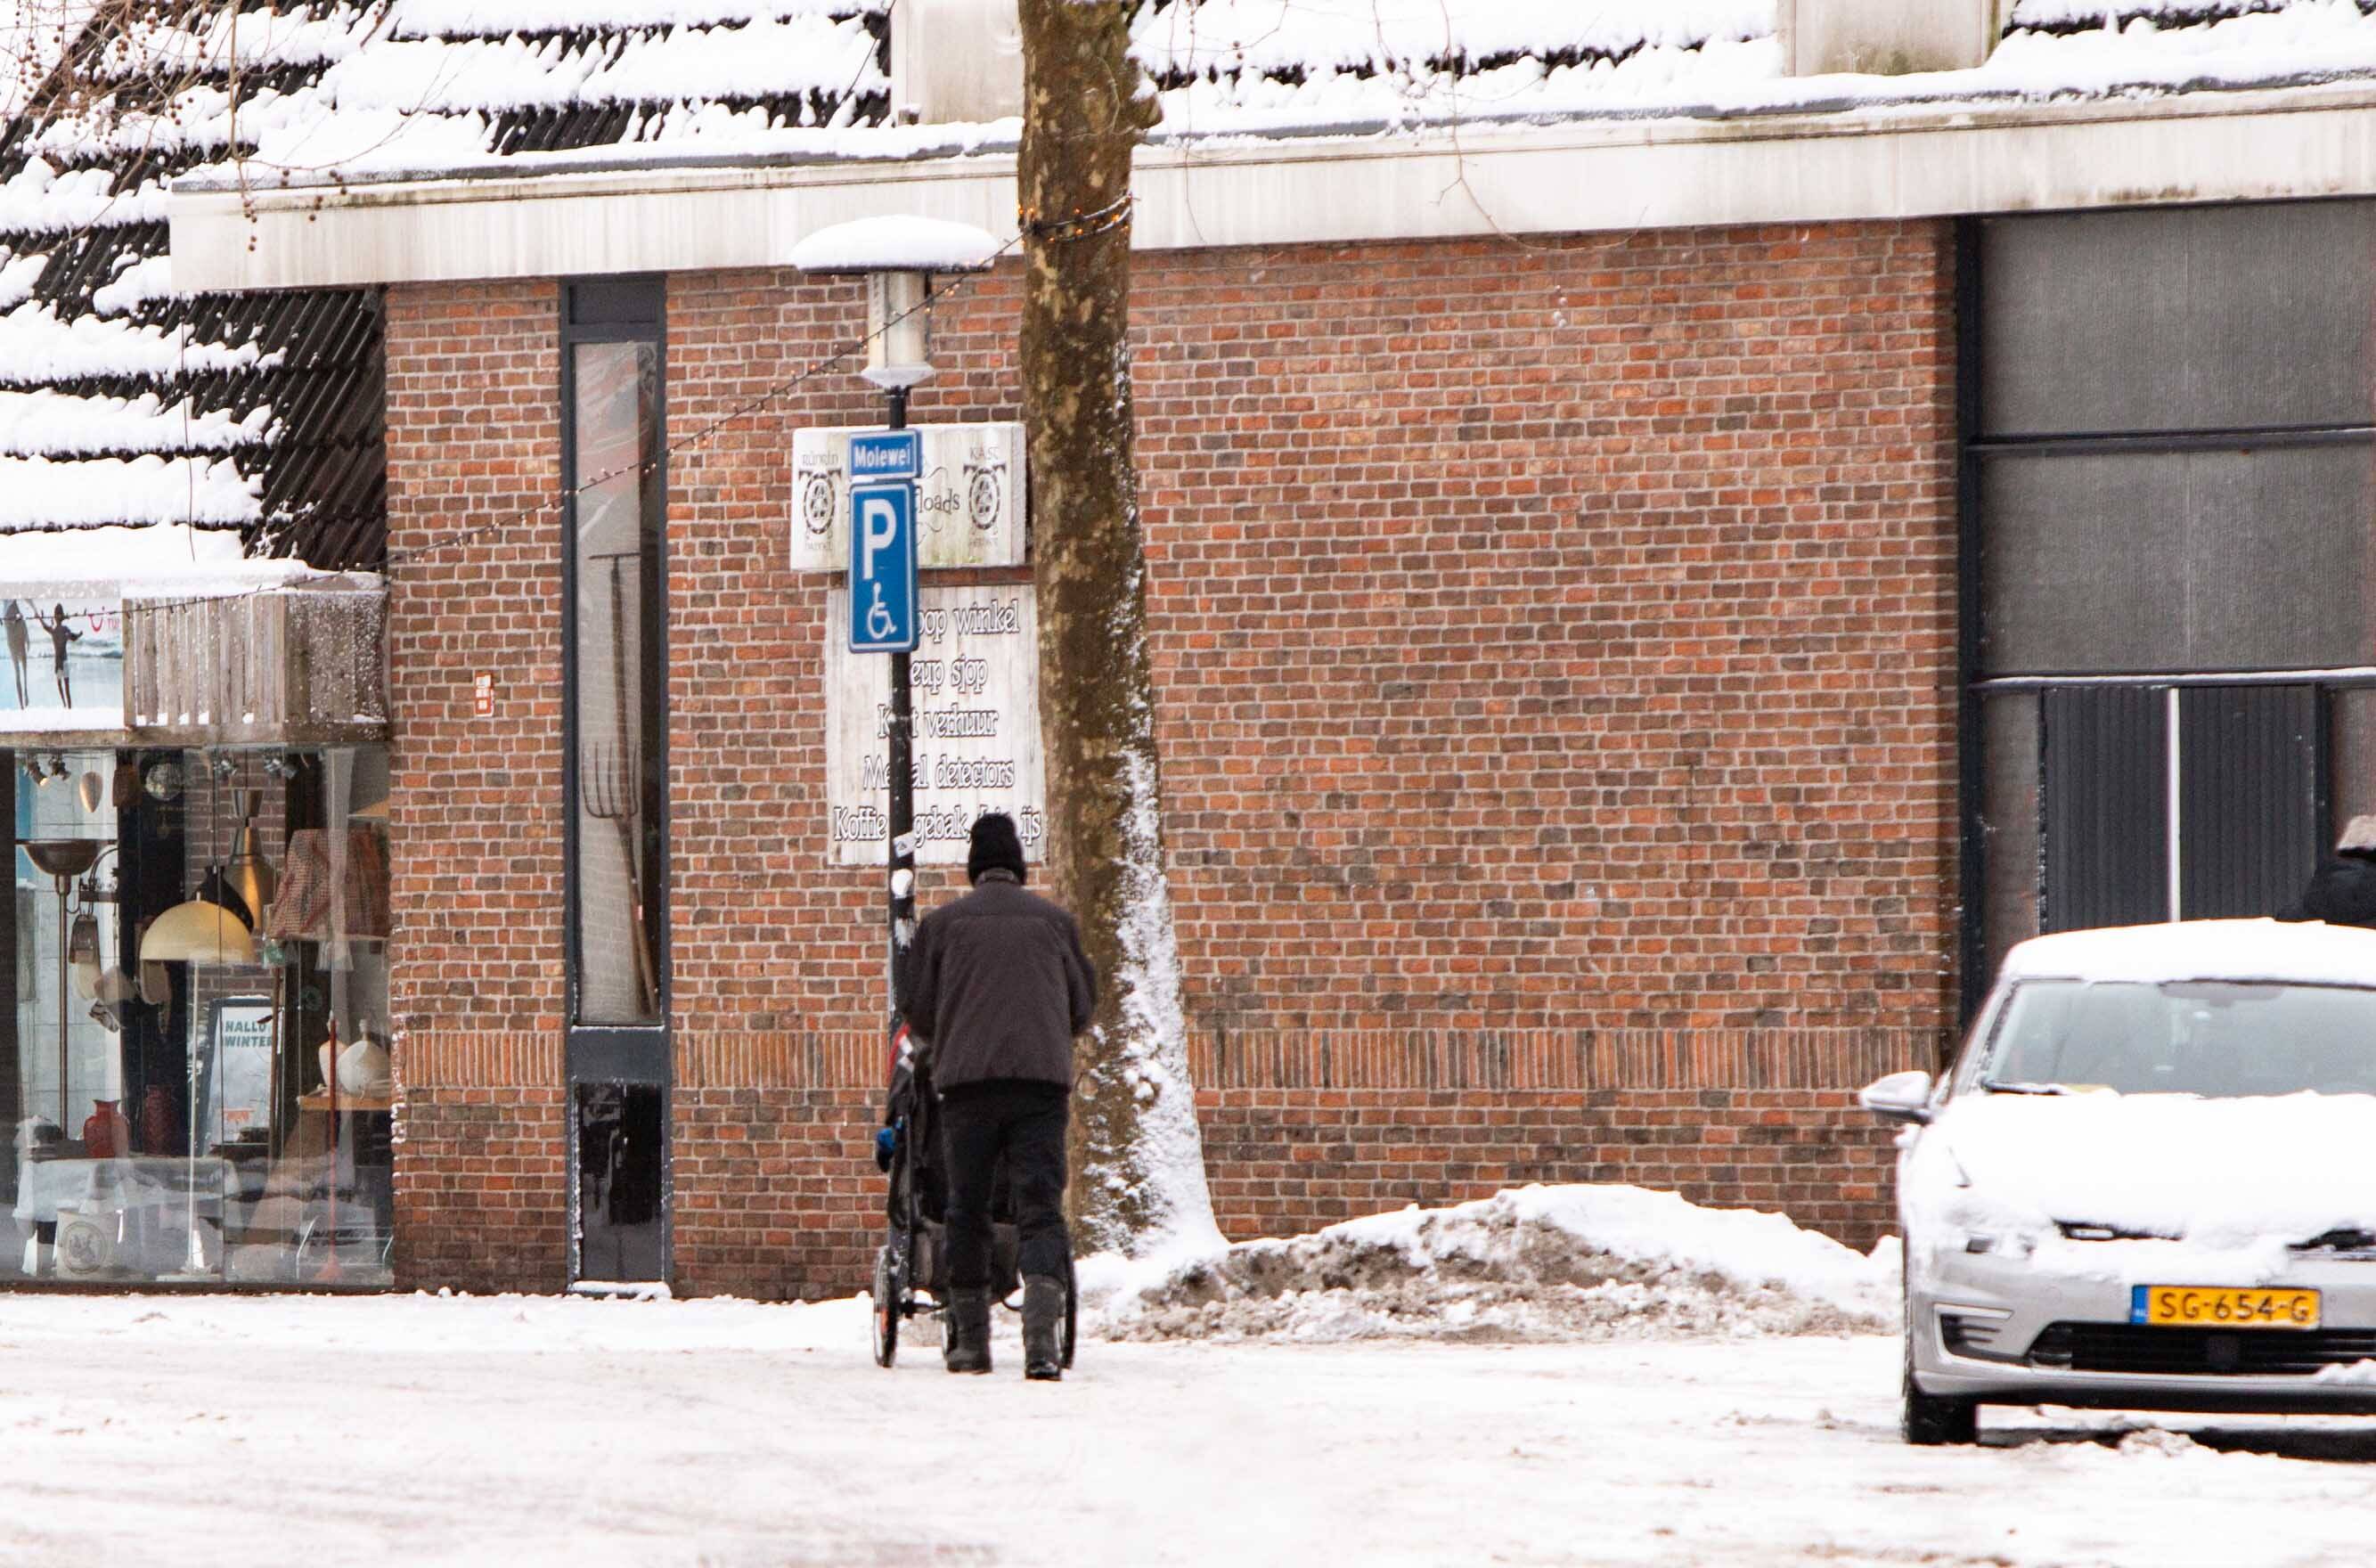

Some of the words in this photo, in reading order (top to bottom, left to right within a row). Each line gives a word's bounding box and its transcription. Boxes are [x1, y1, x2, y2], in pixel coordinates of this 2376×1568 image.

[854, 443, 911, 468] Molewei
[915, 486, 960, 515] loads
[862, 498, 896, 580] P
[952, 598, 1020, 635] winkel
[951, 653, 988, 694] sjop
[923, 702, 999, 739] verhuur
[935, 754, 1015, 789] detectors
[833, 804, 887, 842] Koffie
[2160, 1292, 2310, 1323] SG-654-G
